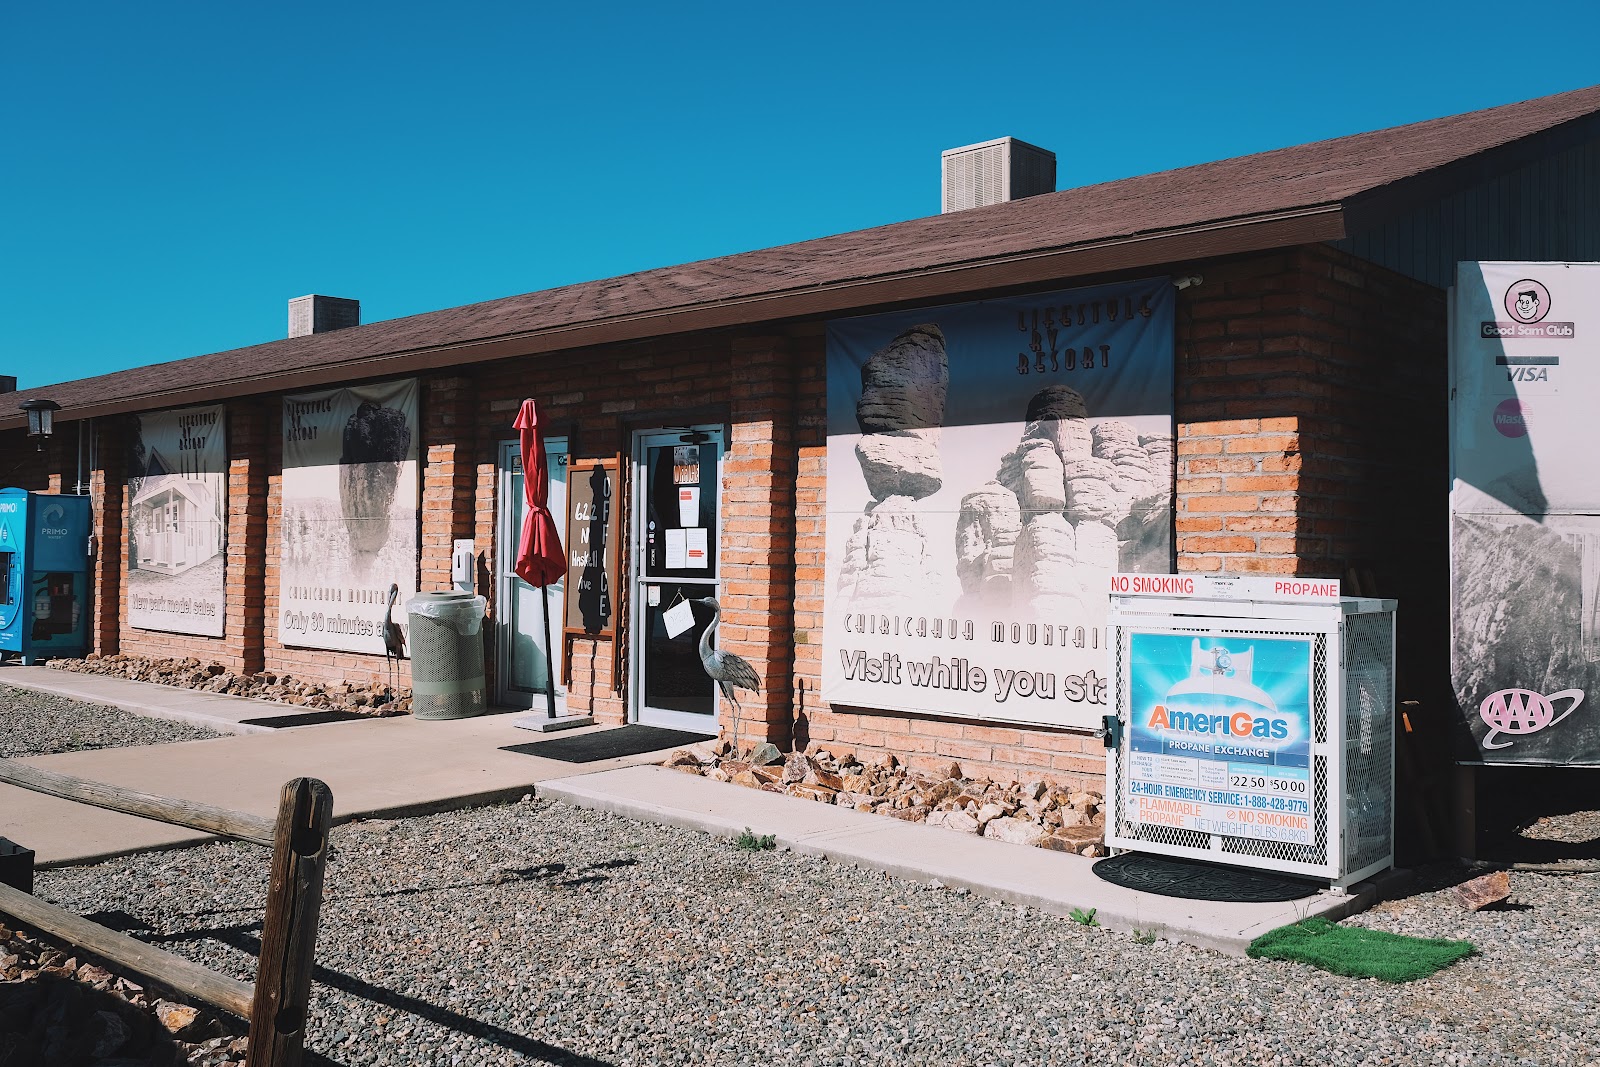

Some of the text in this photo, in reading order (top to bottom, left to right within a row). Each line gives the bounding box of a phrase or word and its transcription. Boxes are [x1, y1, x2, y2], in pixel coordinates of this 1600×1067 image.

[1017, 295, 1152, 332] LIFESTYLE
[1029, 328, 1059, 352] RV
[1483, 324, 1573, 337] Good Sam Club
[1016, 344, 1111, 375] RESORT
[1506, 367, 1549, 382] VISA
[574, 502, 598, 521] 622
[580, 527, 590, 544] N
[599, 476, 612, 617] OFFICE
[571, 550, 598, 568] Haskell
[577, 575, 592, 590] Ave
[1111, 577, 1195, 594] NO SMOKING
[1275, 581, 1338, 597] PROPANE
[132, 594, 216, 616] New park model sales
[284, 610, 309, 634] Only
[311, 612, 325, 632] 30
[327, 613, 374, 637] minutes
[844, 613, 1107, 650] CHIRICAHUA MOUNTAI
[840, 648, 902, 685] Visit
[907, 655, 987, 693] while
[994, 667, 1056, 703] you
[1486, 692, 1546, 731] AAA
[1148, 705, 1289, 740] AmeriGas
[1169, 741, 1270, 758] PROPANE EXCHANGE
[1230, 775, 1265, 789] $22.50
[1270, 779, 1305, 793] $50.00
[1131, 781, 1308, 813] 24-HOUR EMERGENCY SERVICE: 1-888-428-9779
[1139, 797, 1201, 817] FLAMMABLE
[1140, 810, 1185, 827] PROPANE
[1194, 817, 1211, 830] NET
[1211, 820, 1248, 836] WEIGHT
[1239, 811, 1308, 830] NO SMOKING
